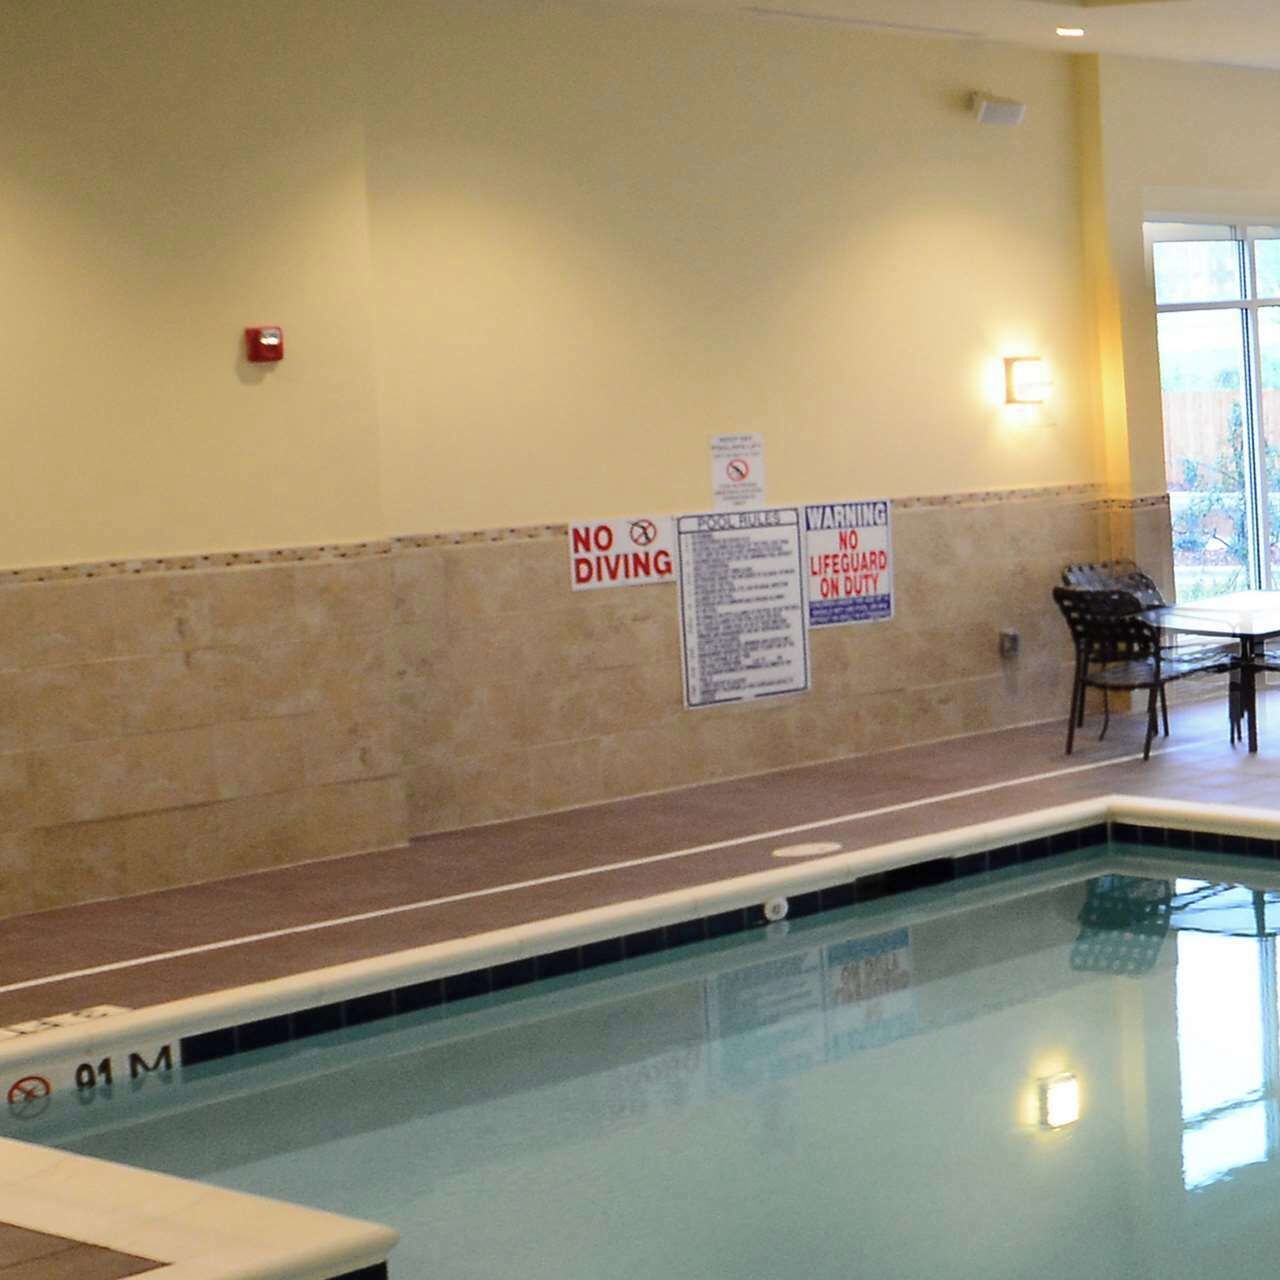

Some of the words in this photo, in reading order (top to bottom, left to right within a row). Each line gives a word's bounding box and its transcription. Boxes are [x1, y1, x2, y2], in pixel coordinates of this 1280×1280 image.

[698, 514, 736, 531] POOL
[738, 511, 781, 528] RULES
[806, 502, 888, 529] WARNING
[573, 525, 613, 552] NO
[839, 529, 858, 549] NO
[574, 549, 672, 584] DIVING
[810, 550, 887, 575] LIFEGUARD
[820, 577, 839, 598] ON
[844, 573, 880, 596] DUTY
[129, 1044, 172, 1079] M
